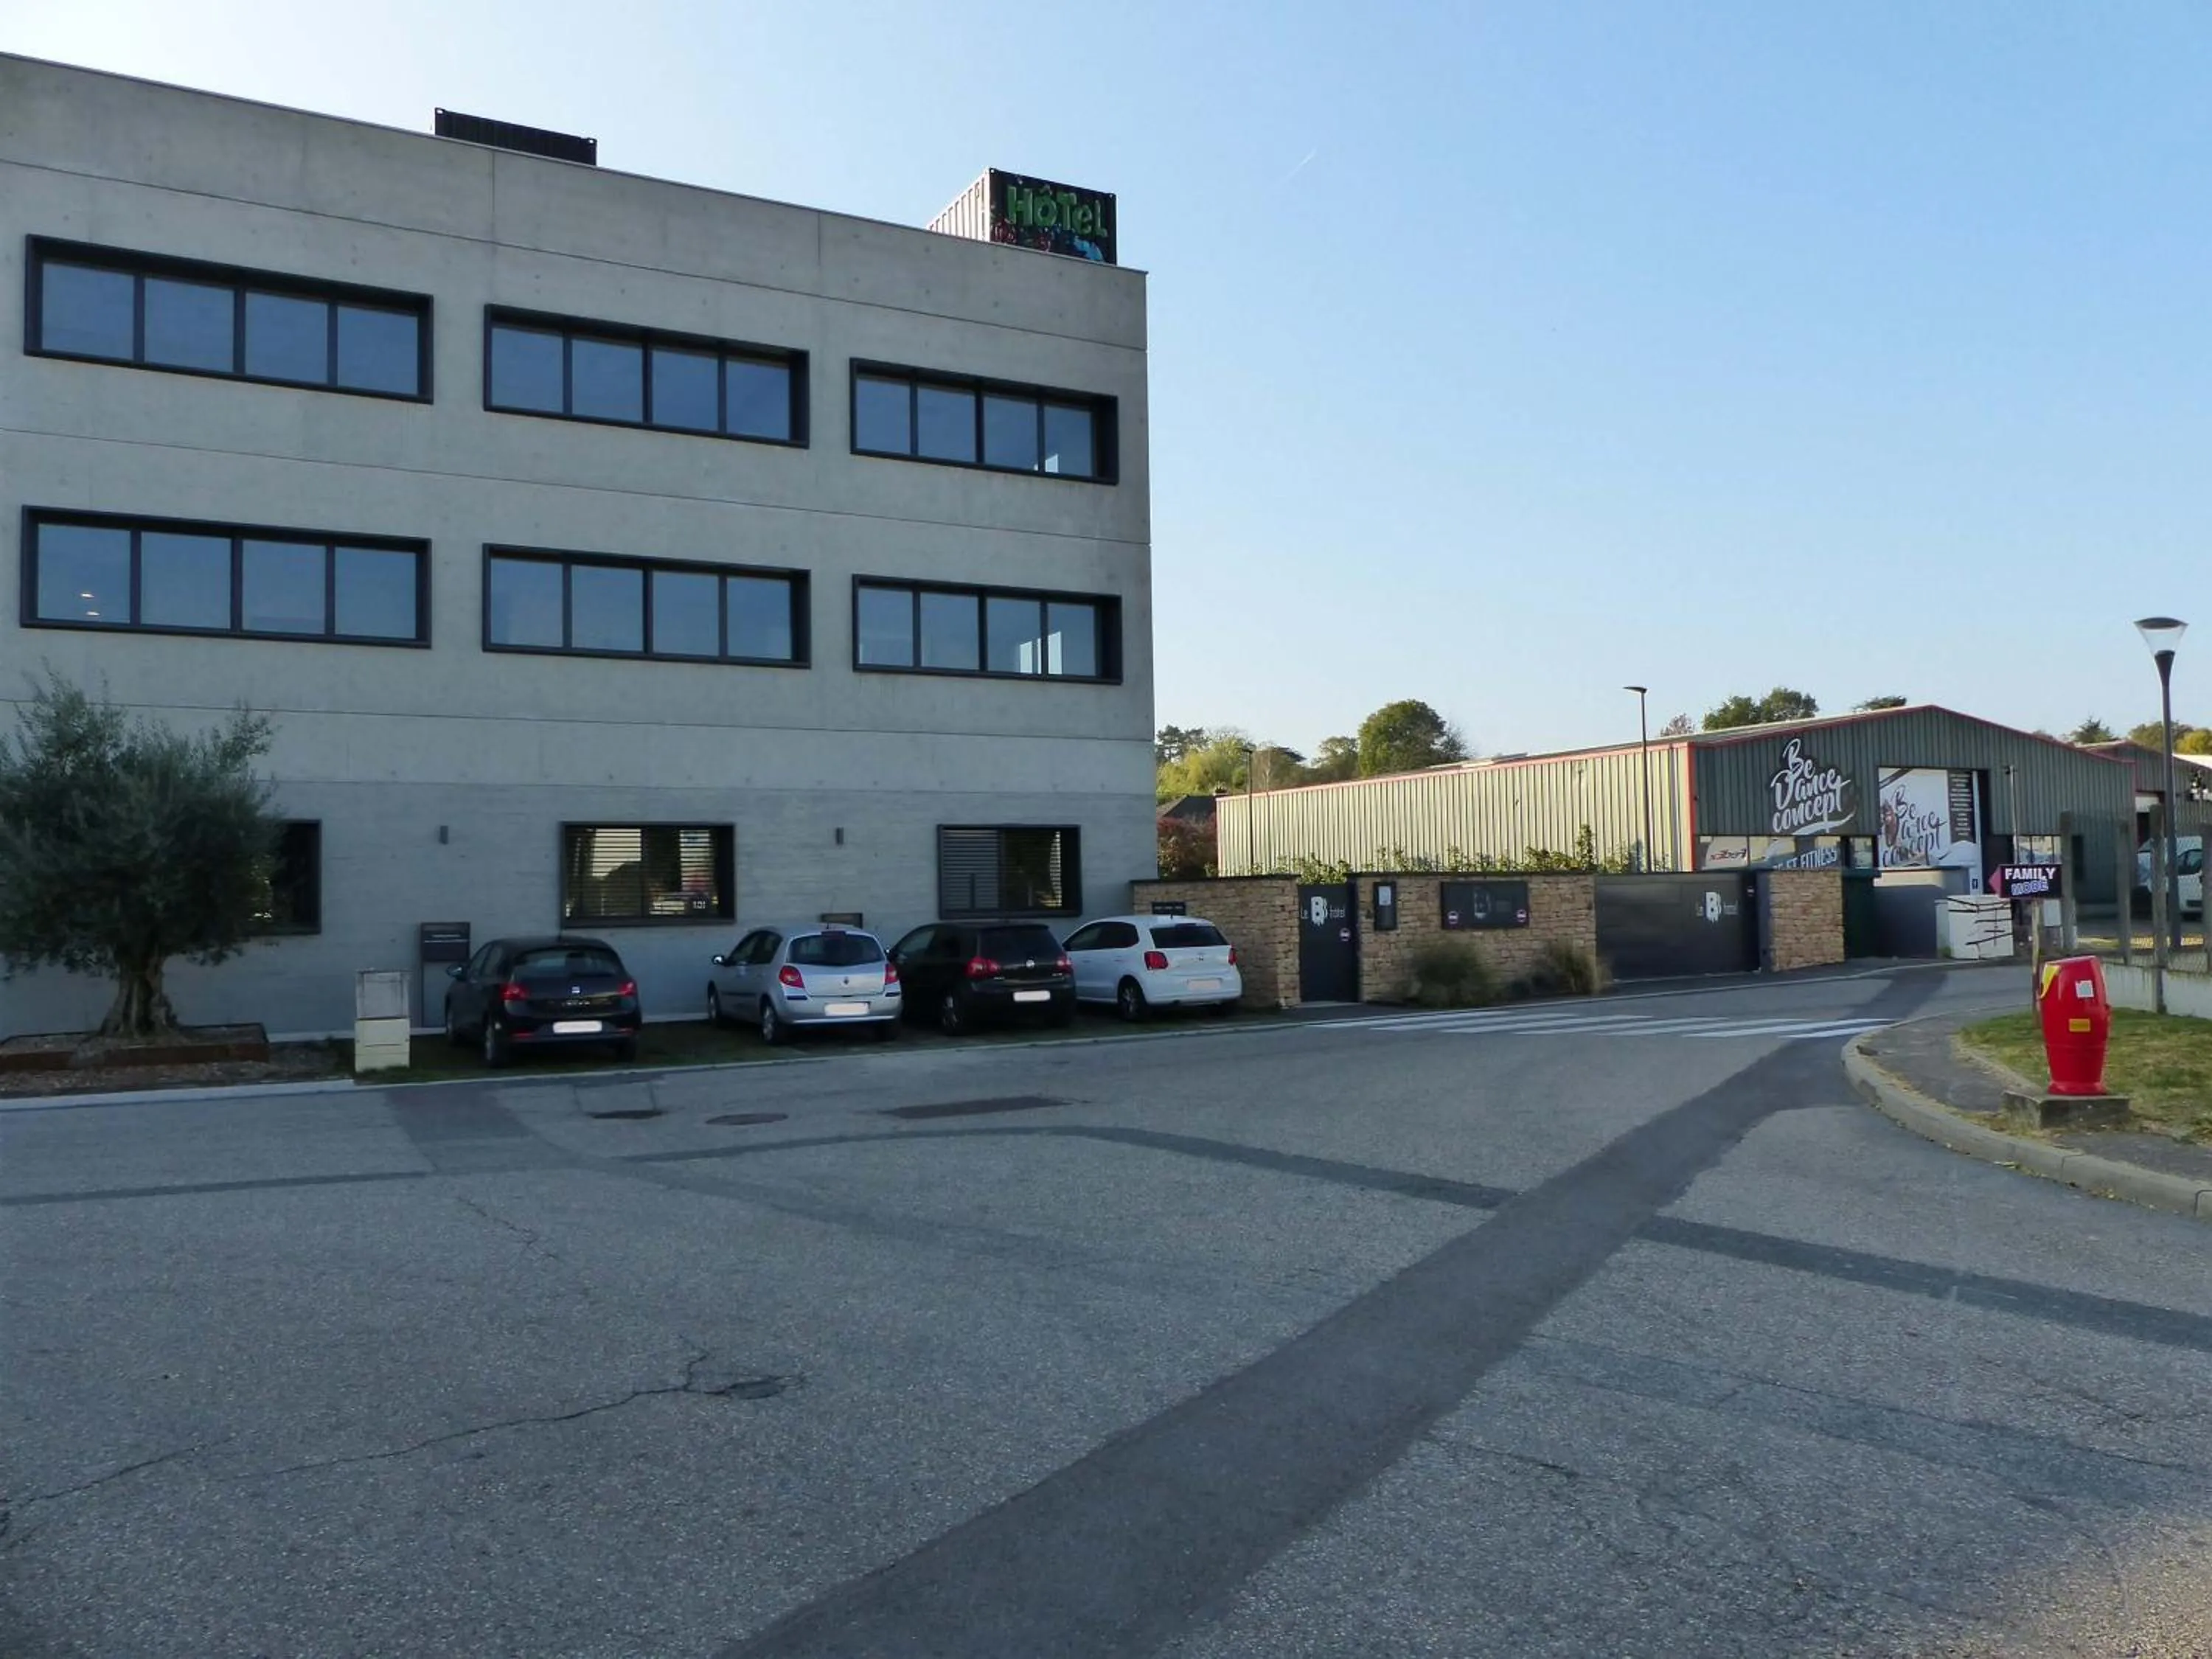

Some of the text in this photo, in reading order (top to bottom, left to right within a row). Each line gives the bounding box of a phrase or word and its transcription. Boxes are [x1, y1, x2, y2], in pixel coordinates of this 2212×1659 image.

[1783, 738, 1815, 782] Be
[1773, 775, 1851, 833] concept
[2005, 868, 2056, 880] FAMILY
